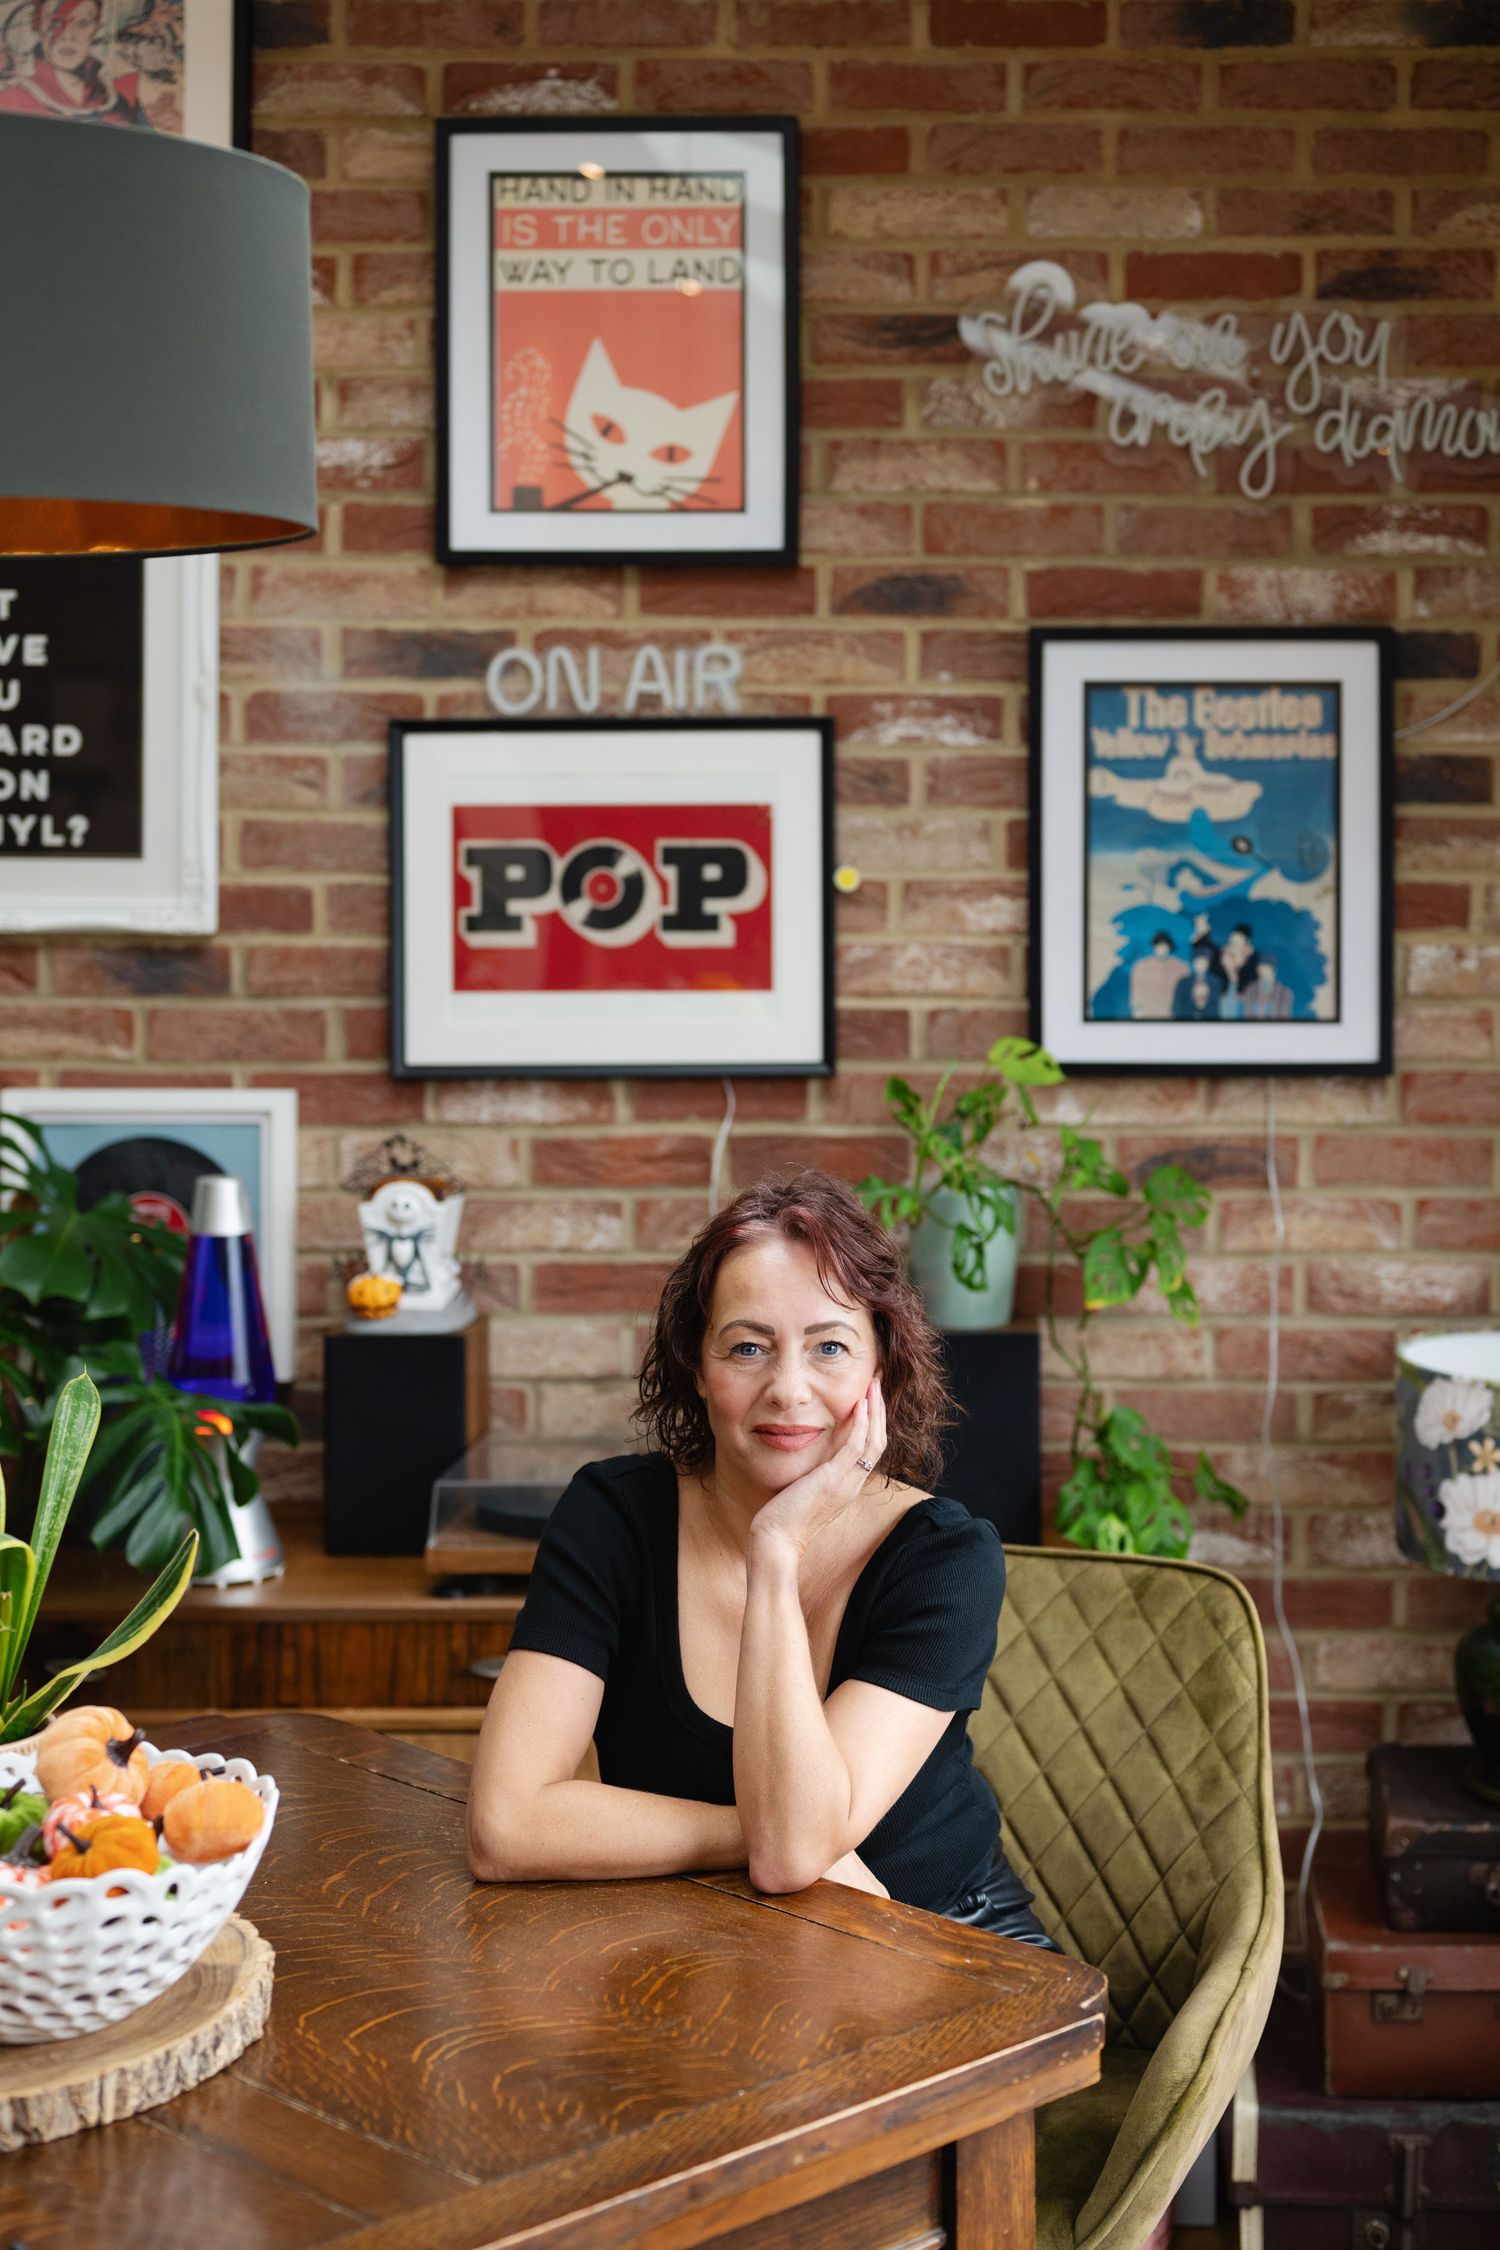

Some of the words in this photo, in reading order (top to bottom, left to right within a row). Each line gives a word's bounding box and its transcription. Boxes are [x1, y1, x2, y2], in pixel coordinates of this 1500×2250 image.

[500, 176, 592, 202] HAND
[605, 177, 635, 201] IN
[651, 177, 740, 201] HAND
[502, 213, 539, 247] IS
[553, 213, 629, 246] THE
[640, 213, 739, 246] ONLY
[501, 257, 574, 285] WAY
[587, 256, 636, 286] TO
[648, 255, 744, 285] LAND
[1269, 309, 1391, 415] you
[486, 644, 600, 717] ON
[622, 643, 745, 714] AIR
[0, 814, 90, 848] YL?
[457, 837, 768, 949] POP
